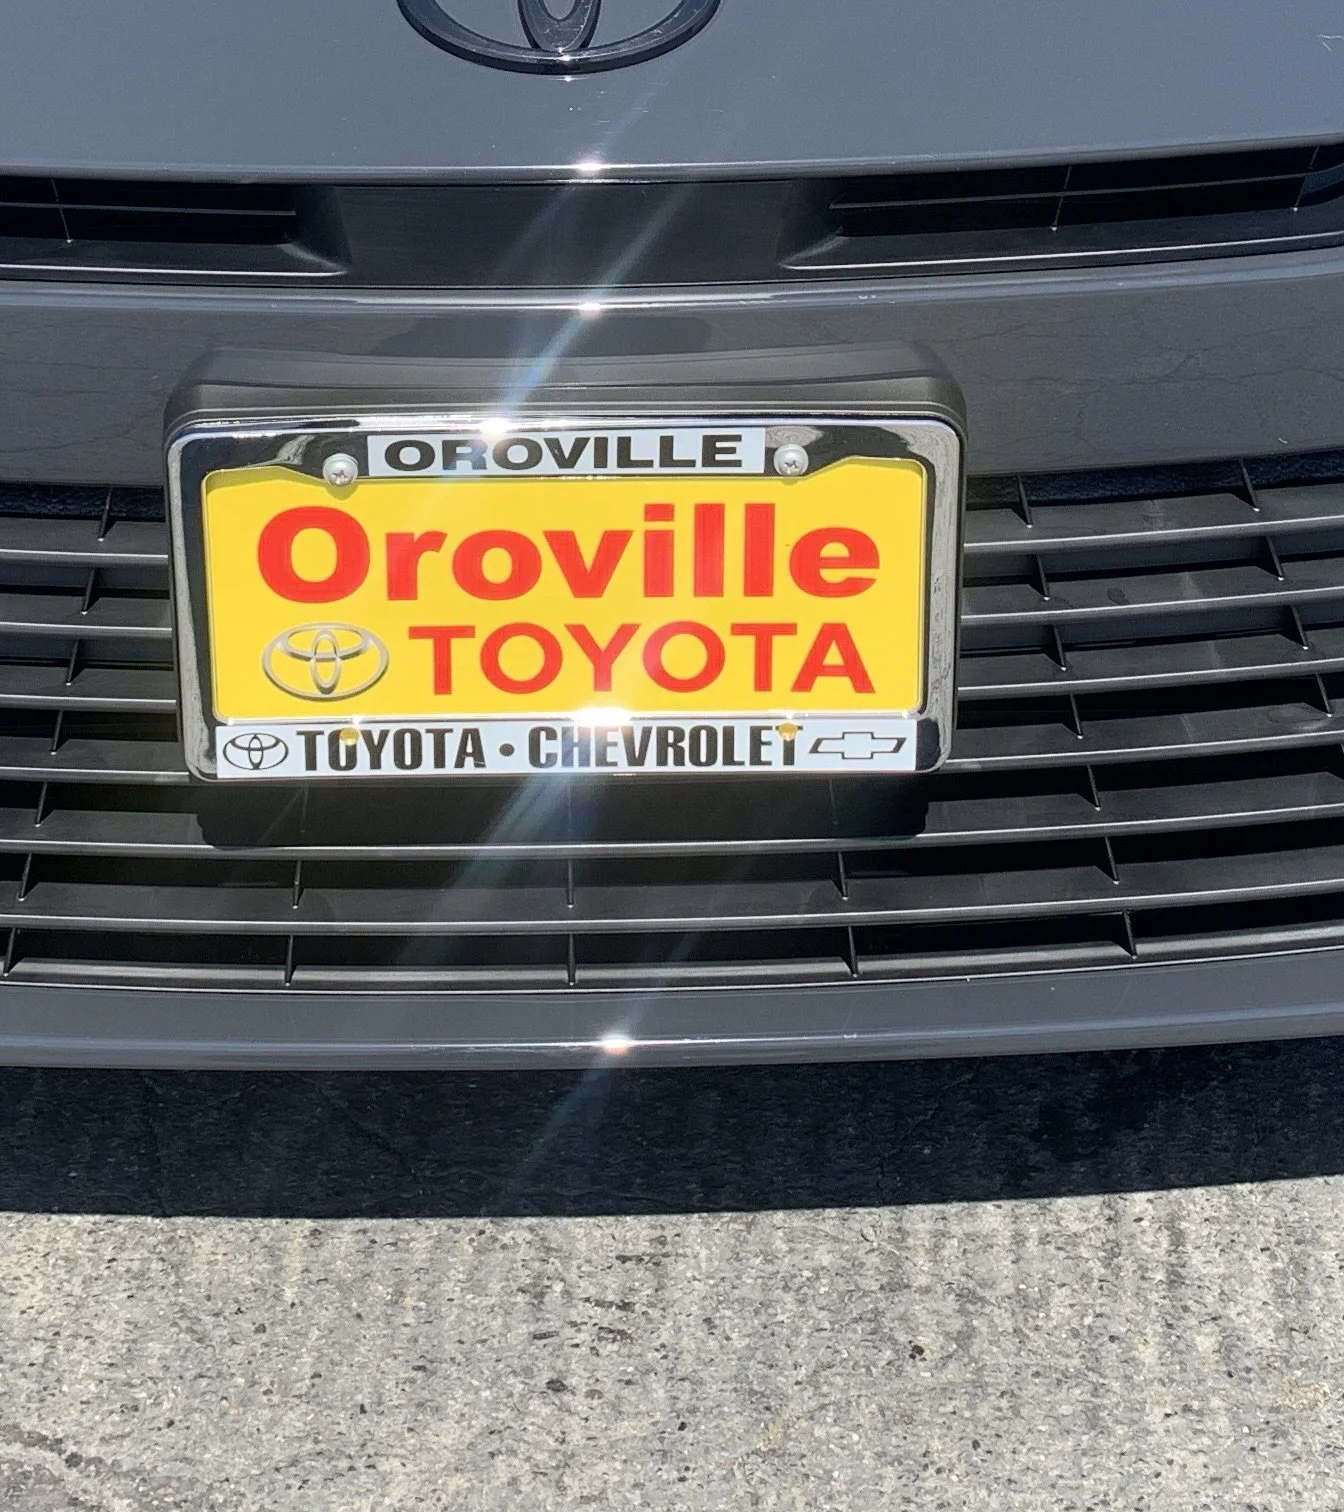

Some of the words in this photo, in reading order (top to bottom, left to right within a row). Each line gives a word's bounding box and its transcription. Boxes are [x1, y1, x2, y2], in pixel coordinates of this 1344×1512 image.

[383, 434, 743, 471] OROVILLE
[256, 502, 881, 604] Oroville
[408, 620, 877, 696] TOYOTA
[296, 726, 487, 771] TOYOTA
[527, 724, 803, 768] CHEVROLET
